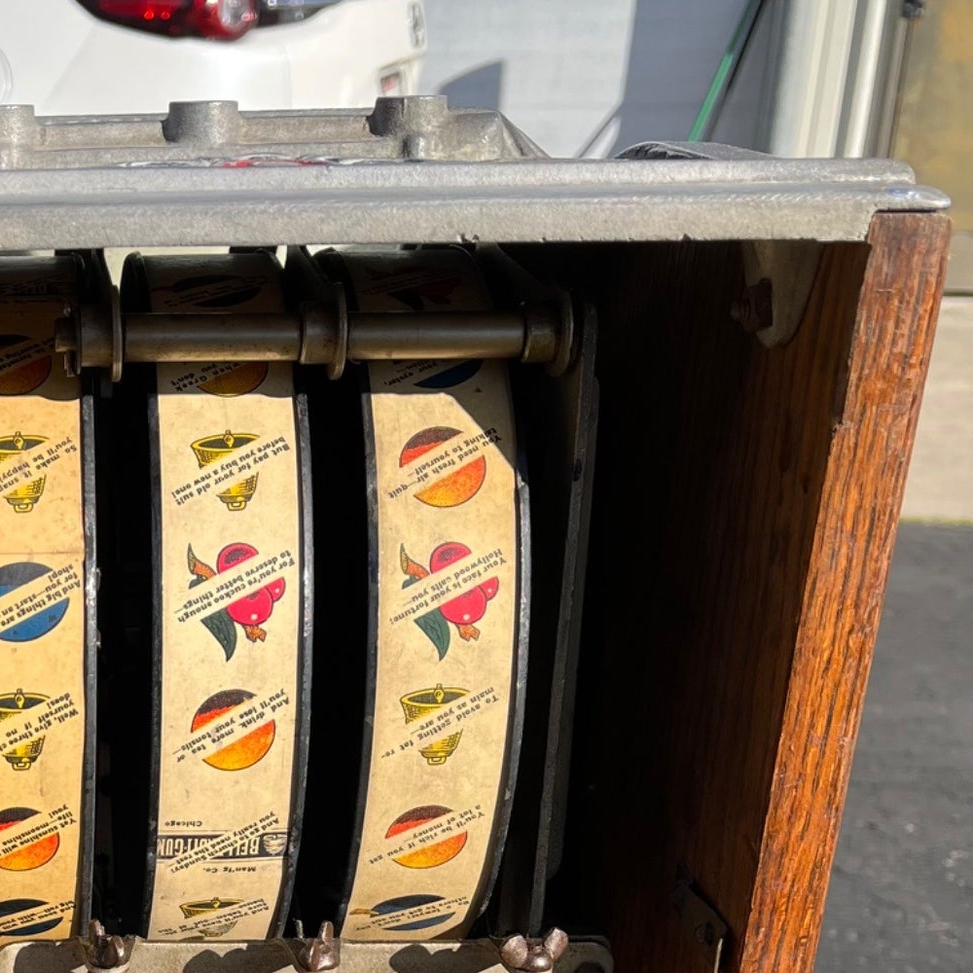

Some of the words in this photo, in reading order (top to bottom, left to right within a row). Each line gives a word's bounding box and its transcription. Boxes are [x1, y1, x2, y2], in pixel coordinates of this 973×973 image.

[170, 373, 195, 386] don't
[175, 376, 207, 392] Greek
[464, 428, 497, 446] talking
[482, 435, 502, 447] You
[47, 437, 72, 455] you'll
[65, 445, 77, 453] So
[253, 436, 285, 454] before
[271, 443, 290, 456] But
[32, 454, 44, 462] be
[239, 450, 253, 462] you
[253, 452, 269, 464] pay
[457, 447, 479, 460] need
[35, 454, 60, 470] make
[221, 460, 237, 472] buy
[237, 462, 251, 473] for
[432, 458, 455, 474] fresh
[23, 470, 32, 478] it
[193, 473, 211, 484] new
[214, 470, 235, 484] your
[171, 484, 191, 498] one!
[197, 483, 211, 494] old
[175, 492, 193, 506] suit
[280, 550, 291, 558] to
[245, 557, 278, 577] deserve
[279, 558, 295, 570] For
[454, 548, 502, 578] Hollywood
[483, 558, 507, 572] Your
[48, 564, 74, 581] shop!
[64, 572, 77, 582] for
[247, 566, 277, 585] you're
[462, 569, 482, 583] face
[62, 580, 81, 595] And
[215, 575, 243, 594] better
[430, 576, 451, 591] calls
[452, 582, 461, 590] is
[46, 591, 61, 602] big
[214, 584, 246, 603] cuckoo
[431, 586, 451, 601] your
[2, 607, 13, 616] an
[17, 601, 45, 618] things
[178, 601, 212, 623] enough
[1, 616, 15, 627] are
[47, 693, 71, 709] does!
[260, 689, 286, 708] you'll
[470, 687, 494, 704] main
[485, 695, 499, 704] To
[271, 697, 289, 712] And
[457, 702, 467, 711] as
[38, 700, 74, 723] yourself
[54, 708, 79, 723] Well,
[239, 706, 257, 720] lose
[437, 708, 455, 721] you
[456, 705, 481, 721] avoid
[24, 722, 32, 730] if
[34, 720, 52, 733] give
[215, 718, 235, 732] your
[239, 712, 265, 728] drink
[6, 728, 18, 738] no
[211, 728, 234, 743] more
[417, 720, 451, 741] getting
[8, 731, 33, 745] three
[191, 744, 206, 754] tea
[399, 740, 414, 750] fat
[381, 749, 395, 758] re-
[48, 804, 68, 817] you!
[459, 809, 473, 817] lot
[59, 818, 76, 828] Yet
[259, 811, 275, 824] you
[456, 812, 485, 827] You'll
[233, 822, 257, 838] really
[261, 818, 279, 831] And
[441, 825, 452, 833] be
[20, 826, 58, 846] sunshine
[239, 833, 247, 841] to
[249, 828, 260, 837] go
[419, 832, 437, 843] rich
[210, 836, 231, 847] need
[2, 844, 18, 854] will
[193, 847, 209, 856] the
[207, 840, 238, 858] church
[387, 846, 404, 856] you
[369, 854, 384, 864] get
[251, 906, 269, 914] And
